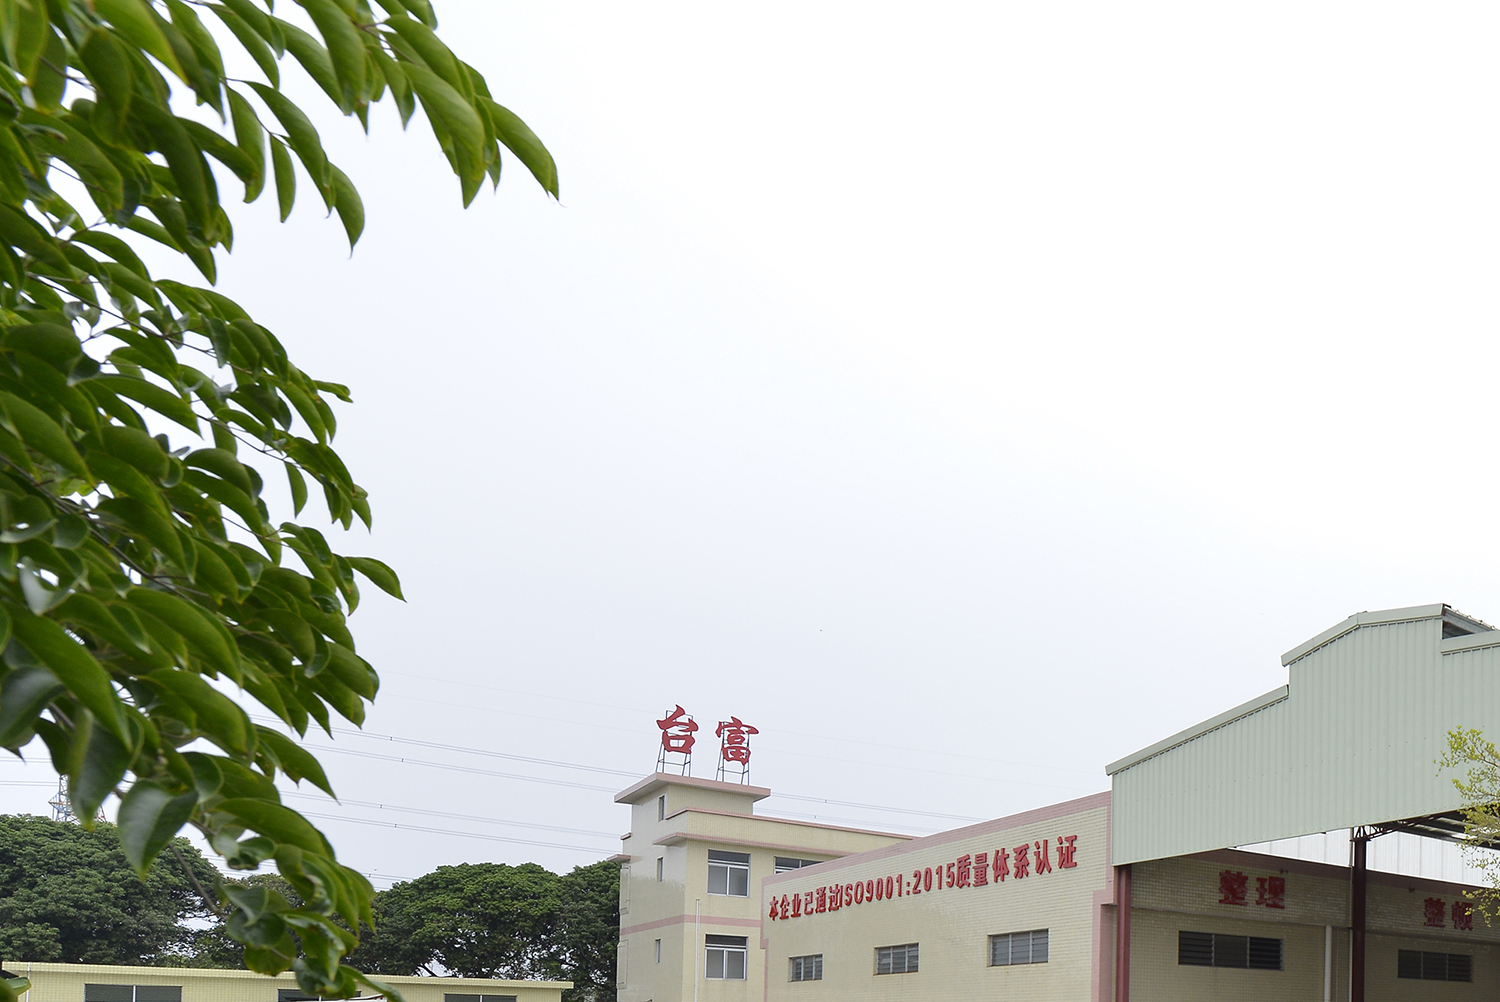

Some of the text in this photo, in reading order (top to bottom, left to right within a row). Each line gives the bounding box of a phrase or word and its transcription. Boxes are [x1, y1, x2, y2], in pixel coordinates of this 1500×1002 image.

[656, 704, 759, 766] 台富
[1218, 870, 1286, 909] 整理
[1423, 897, 1474, 931] 整顿
